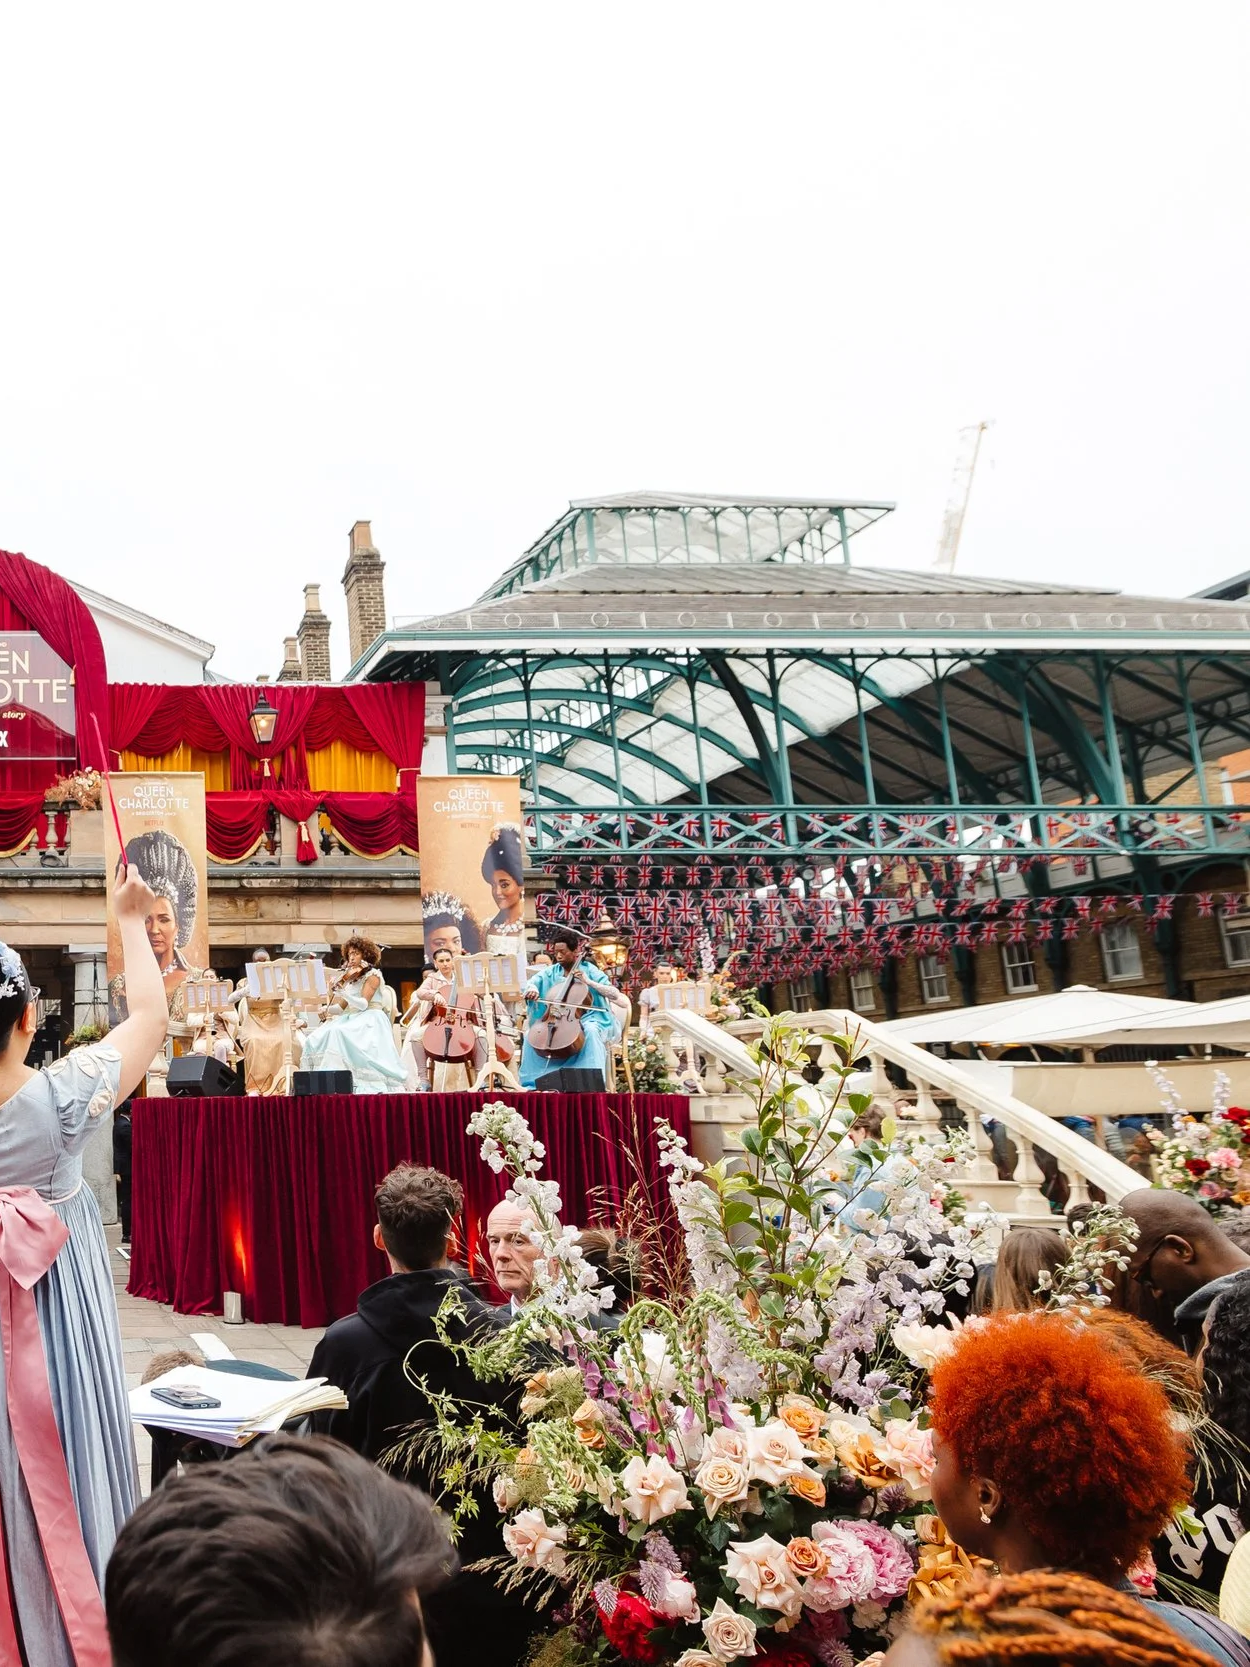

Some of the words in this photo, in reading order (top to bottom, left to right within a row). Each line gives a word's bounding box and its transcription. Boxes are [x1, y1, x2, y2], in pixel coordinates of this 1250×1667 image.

[2, 710, 27, 721] story
[133, 785, 174, 798] QUEEN
[448, 788, 490, 800] QUEEN
[118, 798, 189, 809] CHARLOTTE
[433, 801, 505, 813] CHARLOTTE
